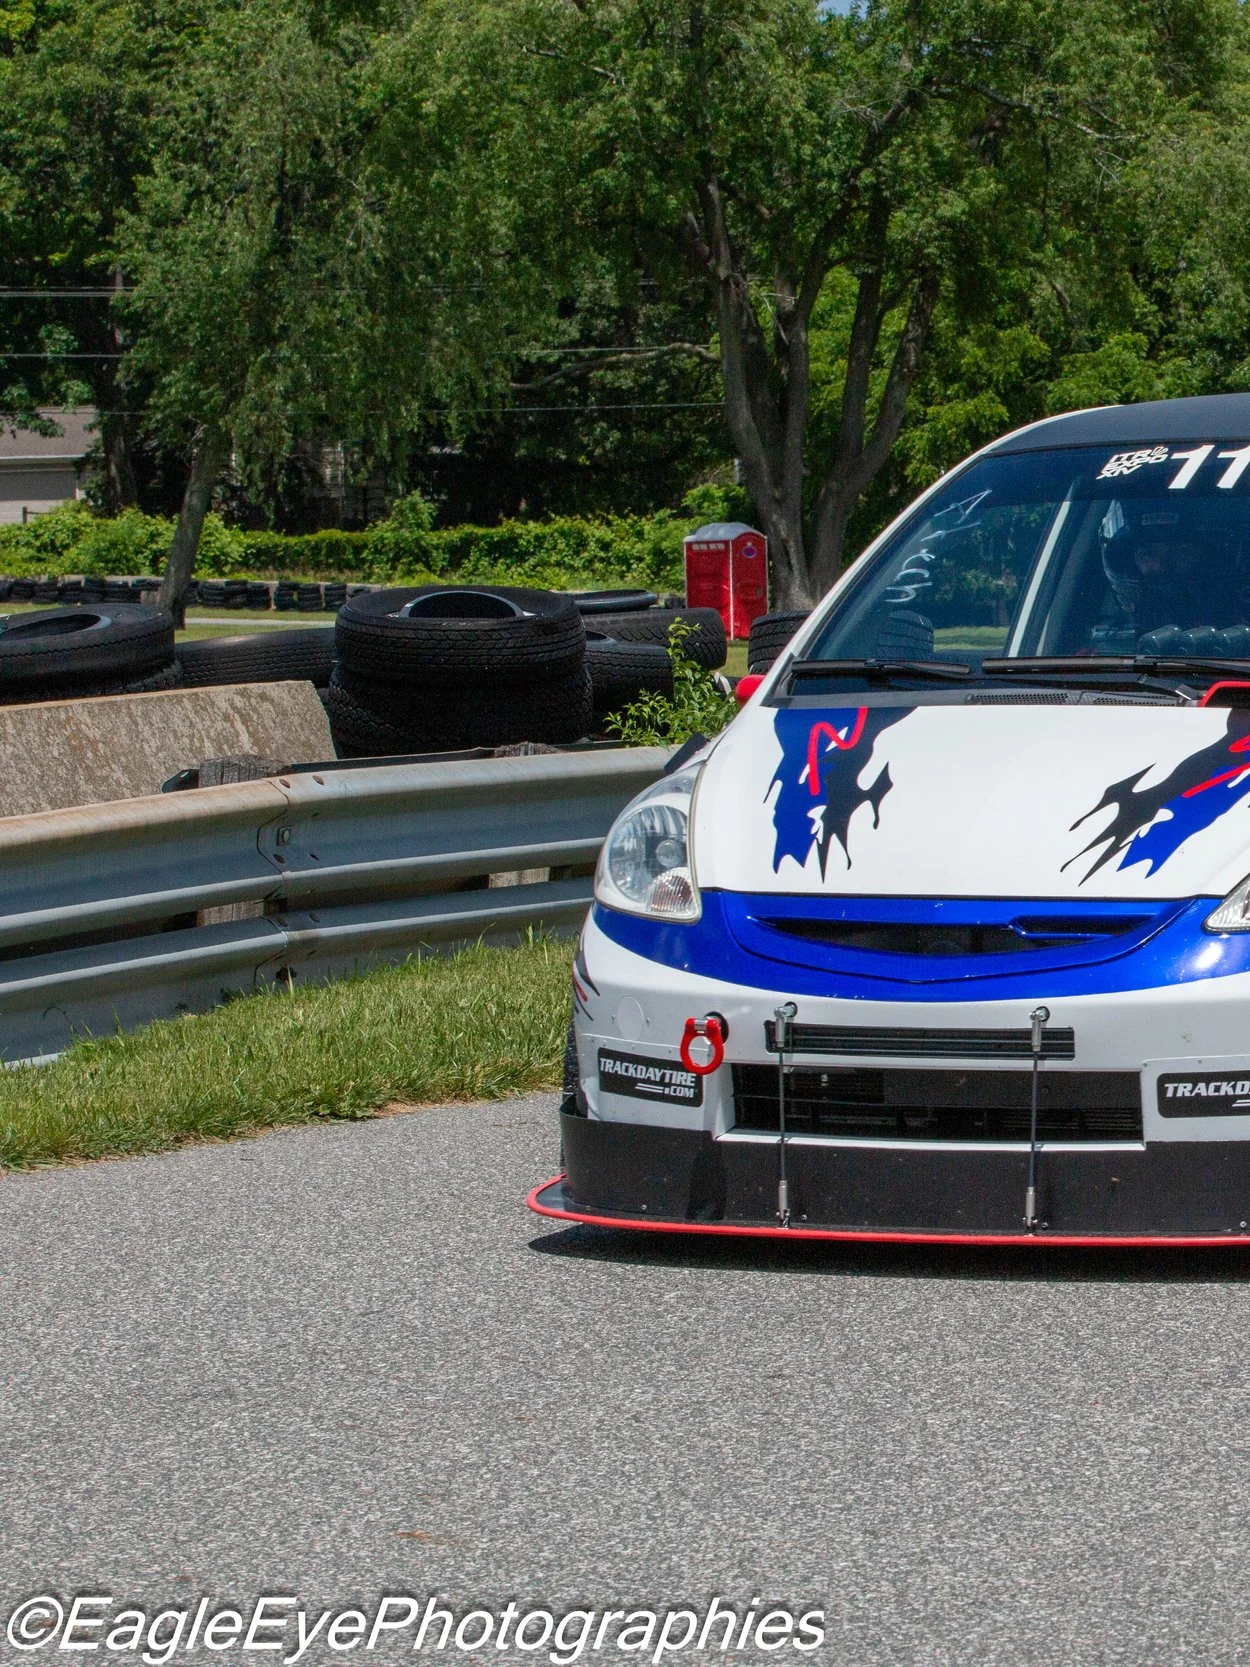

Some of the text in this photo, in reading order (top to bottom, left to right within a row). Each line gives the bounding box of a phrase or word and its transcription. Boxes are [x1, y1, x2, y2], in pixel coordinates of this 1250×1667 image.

[1101, 454, 1169, 474] EXPO
[1109, 449, 1153, 463] ITR
[1095, 464, 1143, 480] XIV
[600, 1058, 697, 1086] TRACKDAYTIRE
